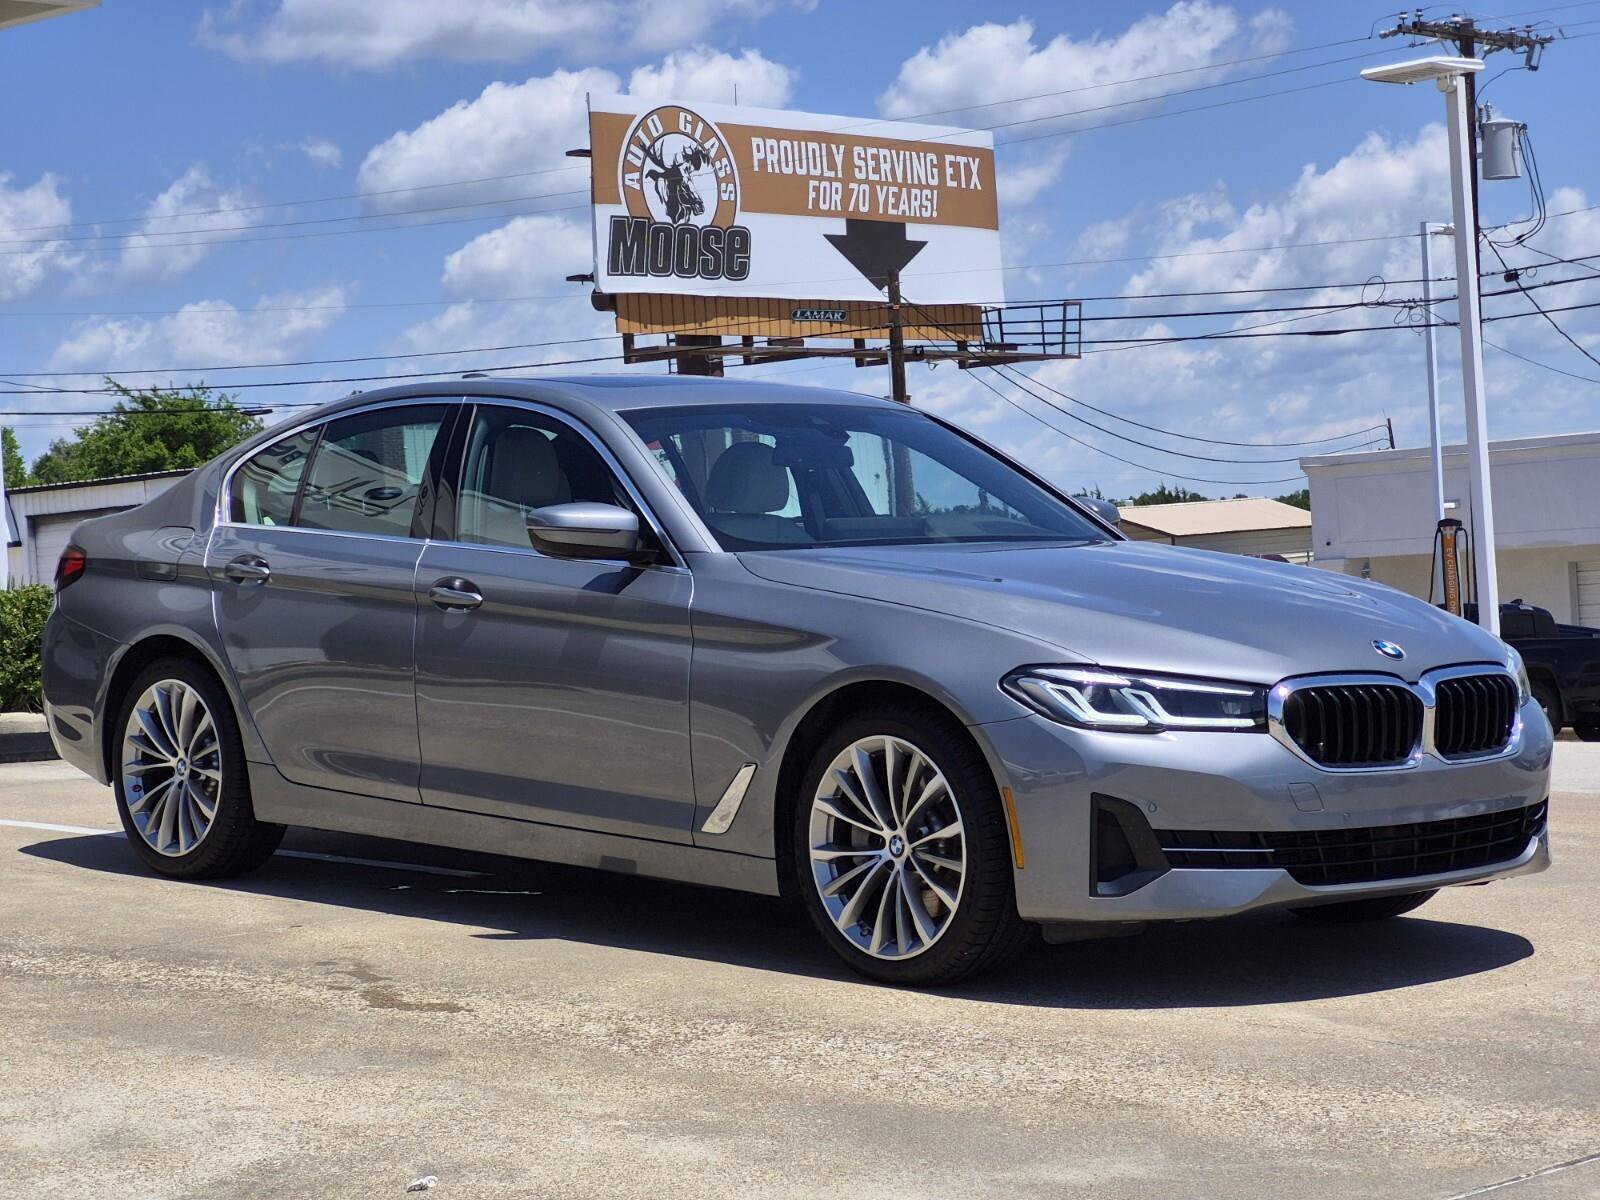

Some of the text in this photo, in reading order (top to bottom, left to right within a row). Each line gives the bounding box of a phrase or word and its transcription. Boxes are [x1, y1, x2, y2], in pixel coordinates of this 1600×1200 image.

[624, 111, 735, 201] AUTO GLASS
[751, 137, 982, 190] PROUDLY SERVING ETX
[808, 180, 938, 218] FOR 70 YEARS!
[796, 310, 842, 320] LAMAR
[1446, 547, 1454, 559] EV
[1447, 560, 1456, 599] CHARGING
